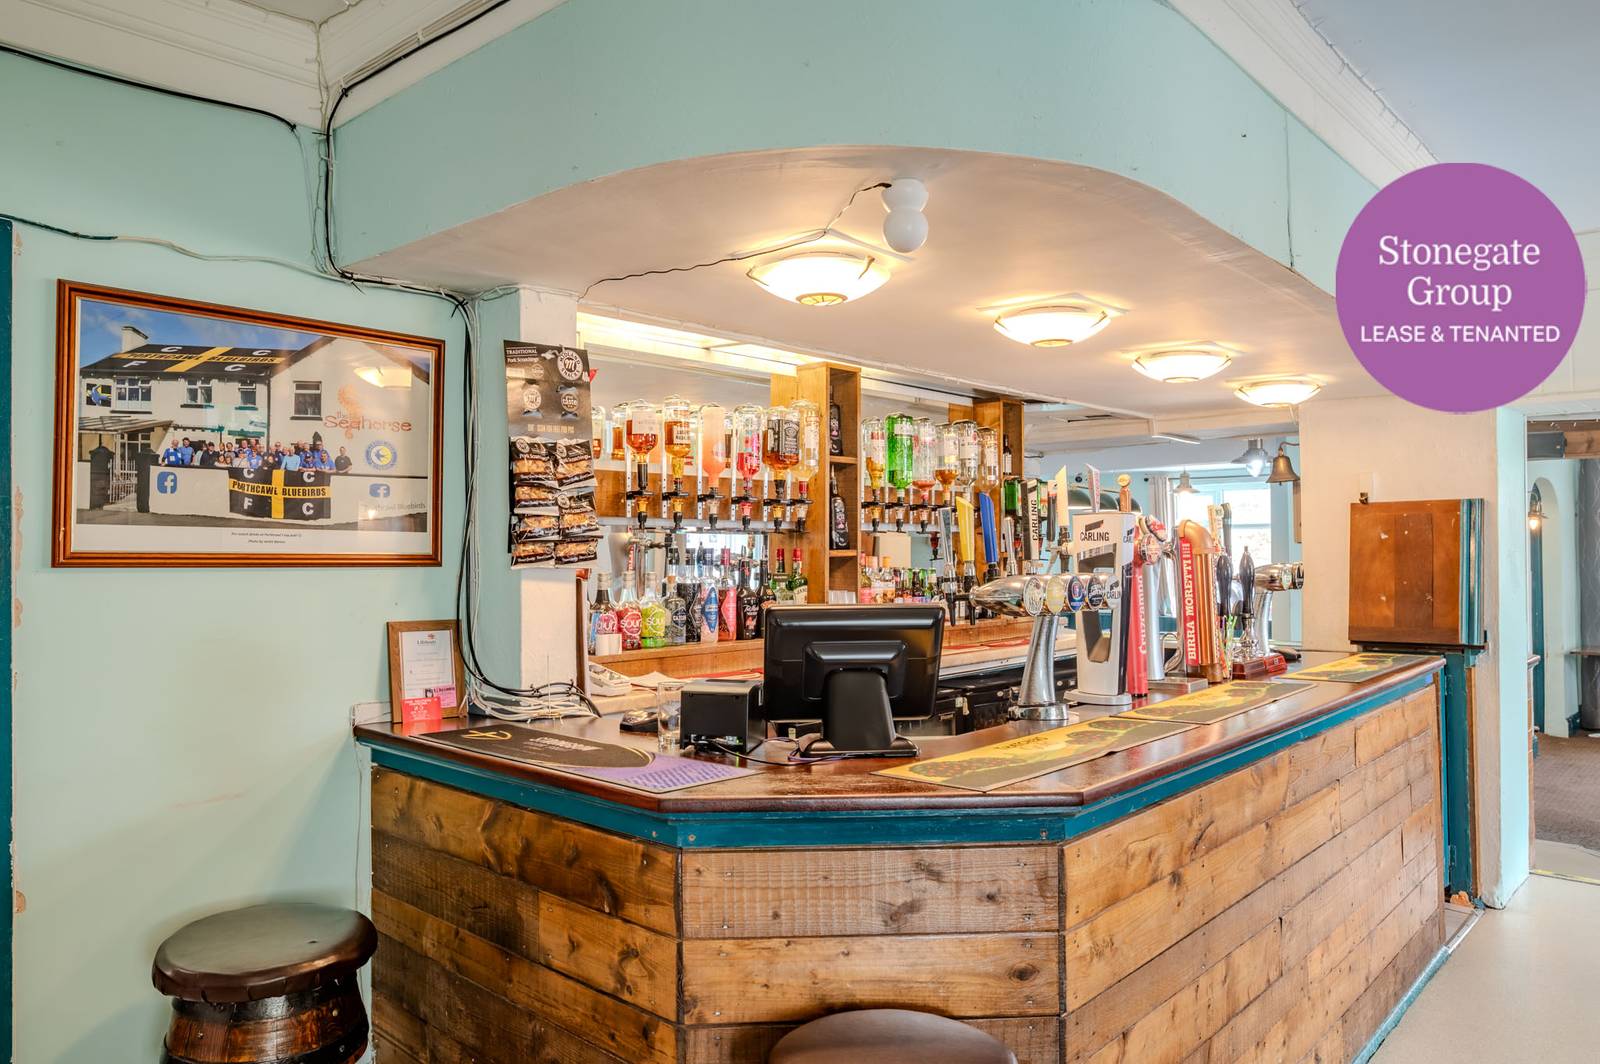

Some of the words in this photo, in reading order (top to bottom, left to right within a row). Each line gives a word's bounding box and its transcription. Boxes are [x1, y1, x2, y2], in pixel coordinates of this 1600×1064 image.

[281, 487, 327, 497] BLUEBIRDS
[244, 496, 254, 510] F
[301, 502, 315, 516] C
[1030, 499, 1039, 541] CARLING
[1079, 531, 1110, 542] CARLING
[1183, 560, 1196, 617] MORETTI
[1186, 620, 1197, 661] BIRRA
